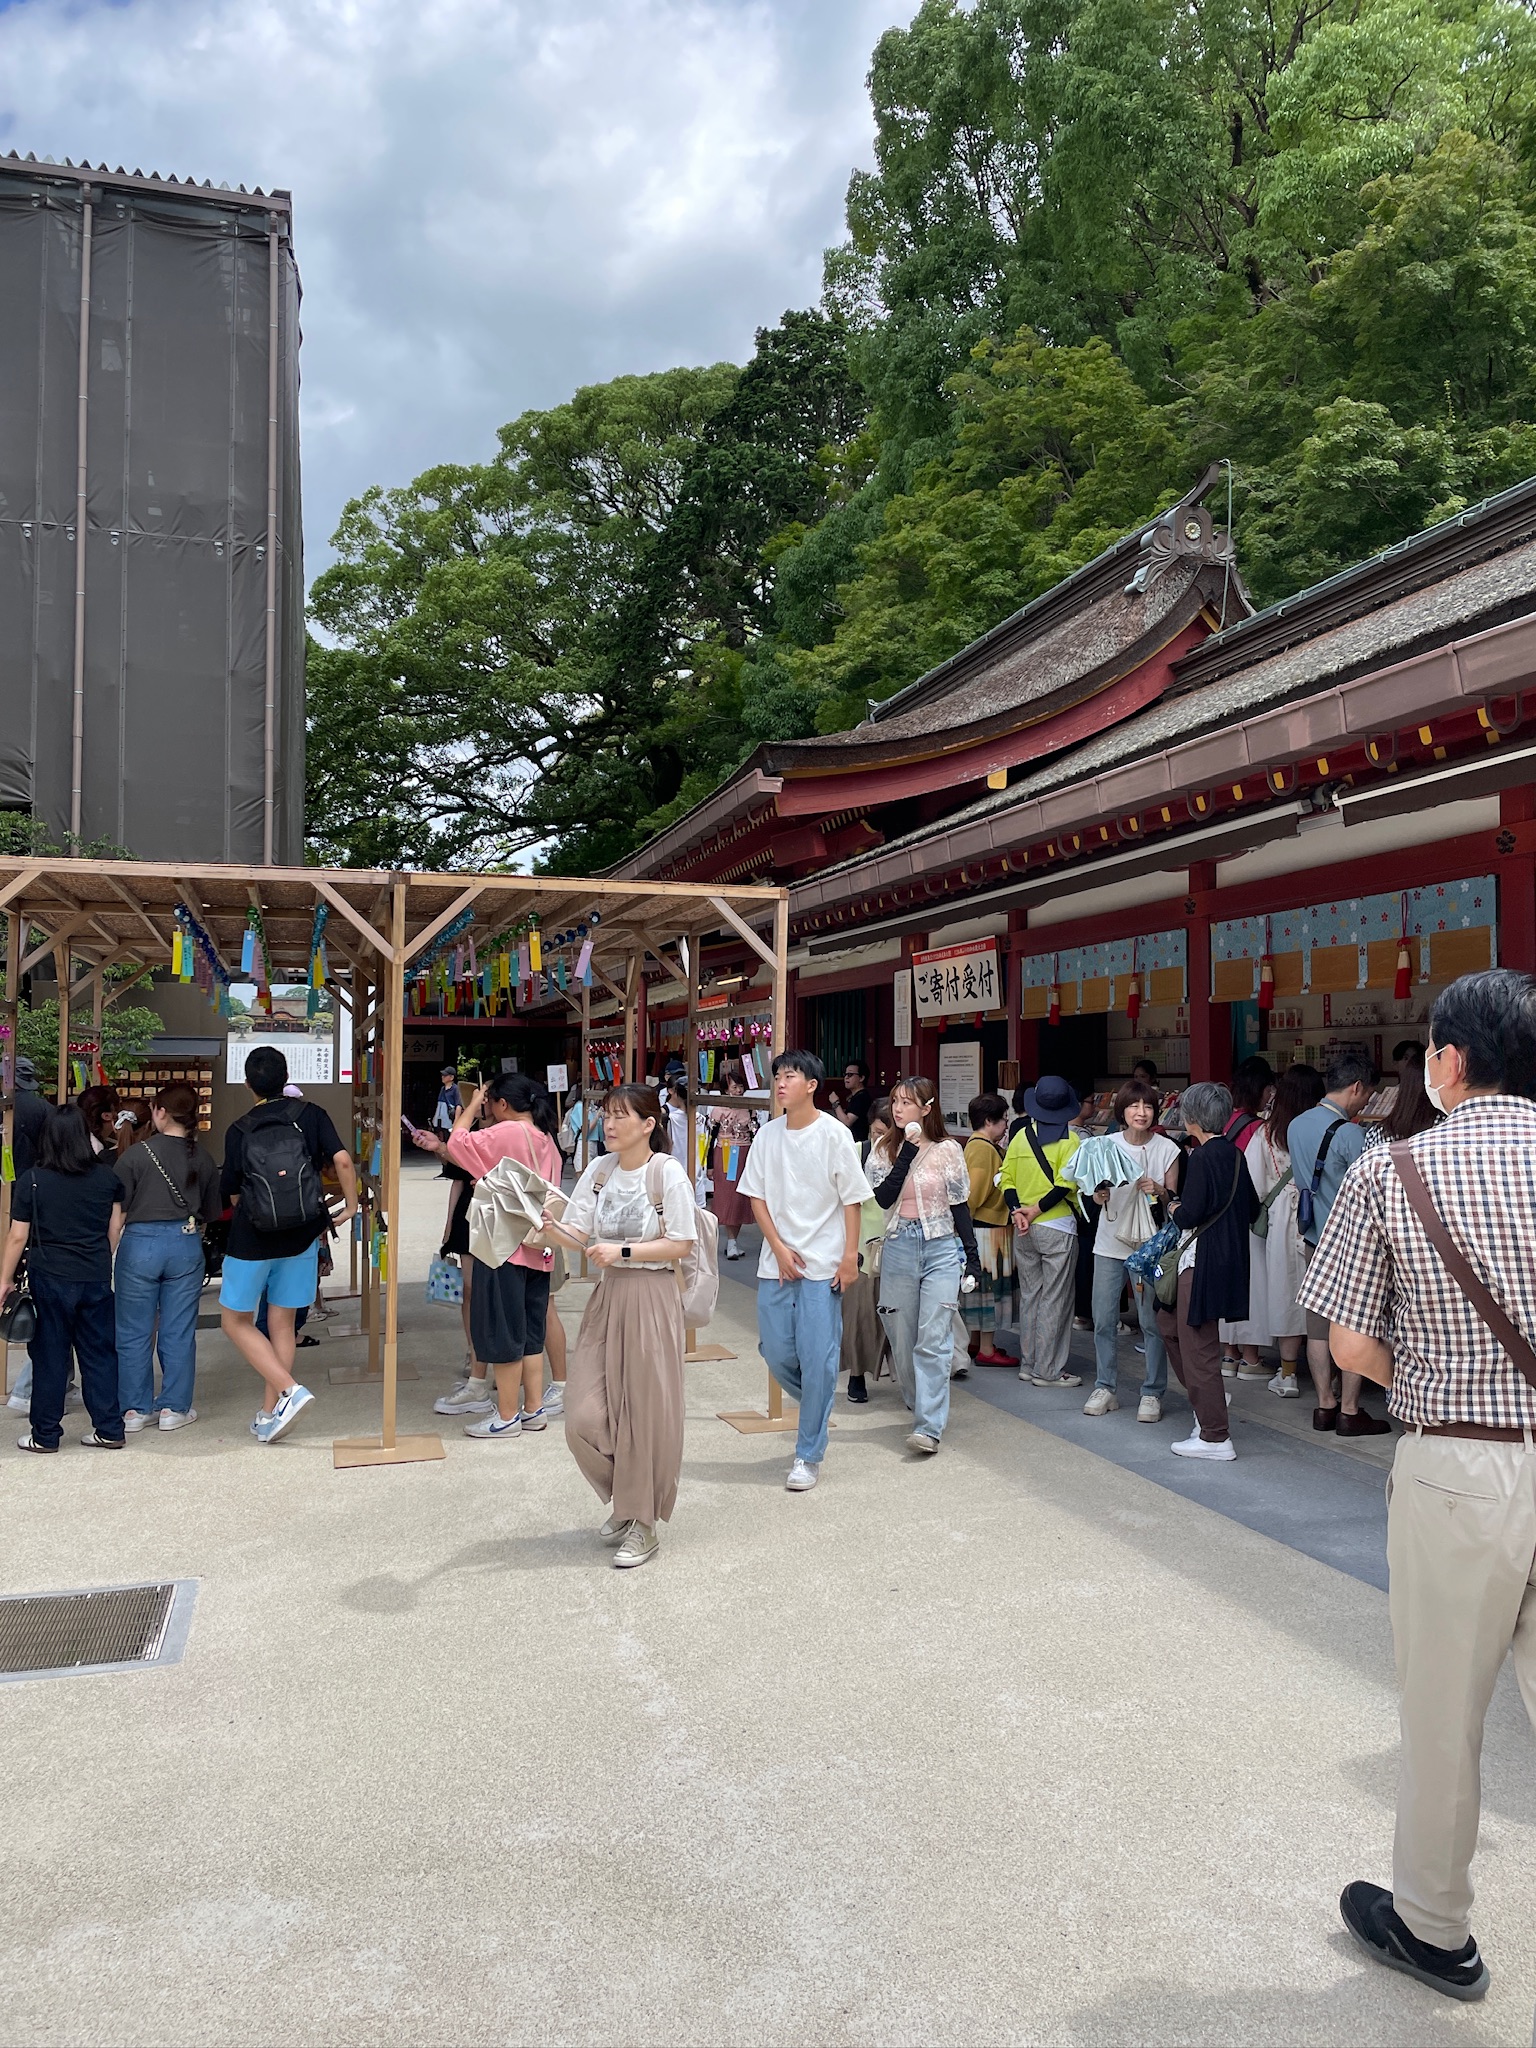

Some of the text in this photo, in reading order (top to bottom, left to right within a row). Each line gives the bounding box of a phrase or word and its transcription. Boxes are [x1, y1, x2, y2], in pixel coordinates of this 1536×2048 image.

[918, 960, 994, 1005] ご寄付受付
